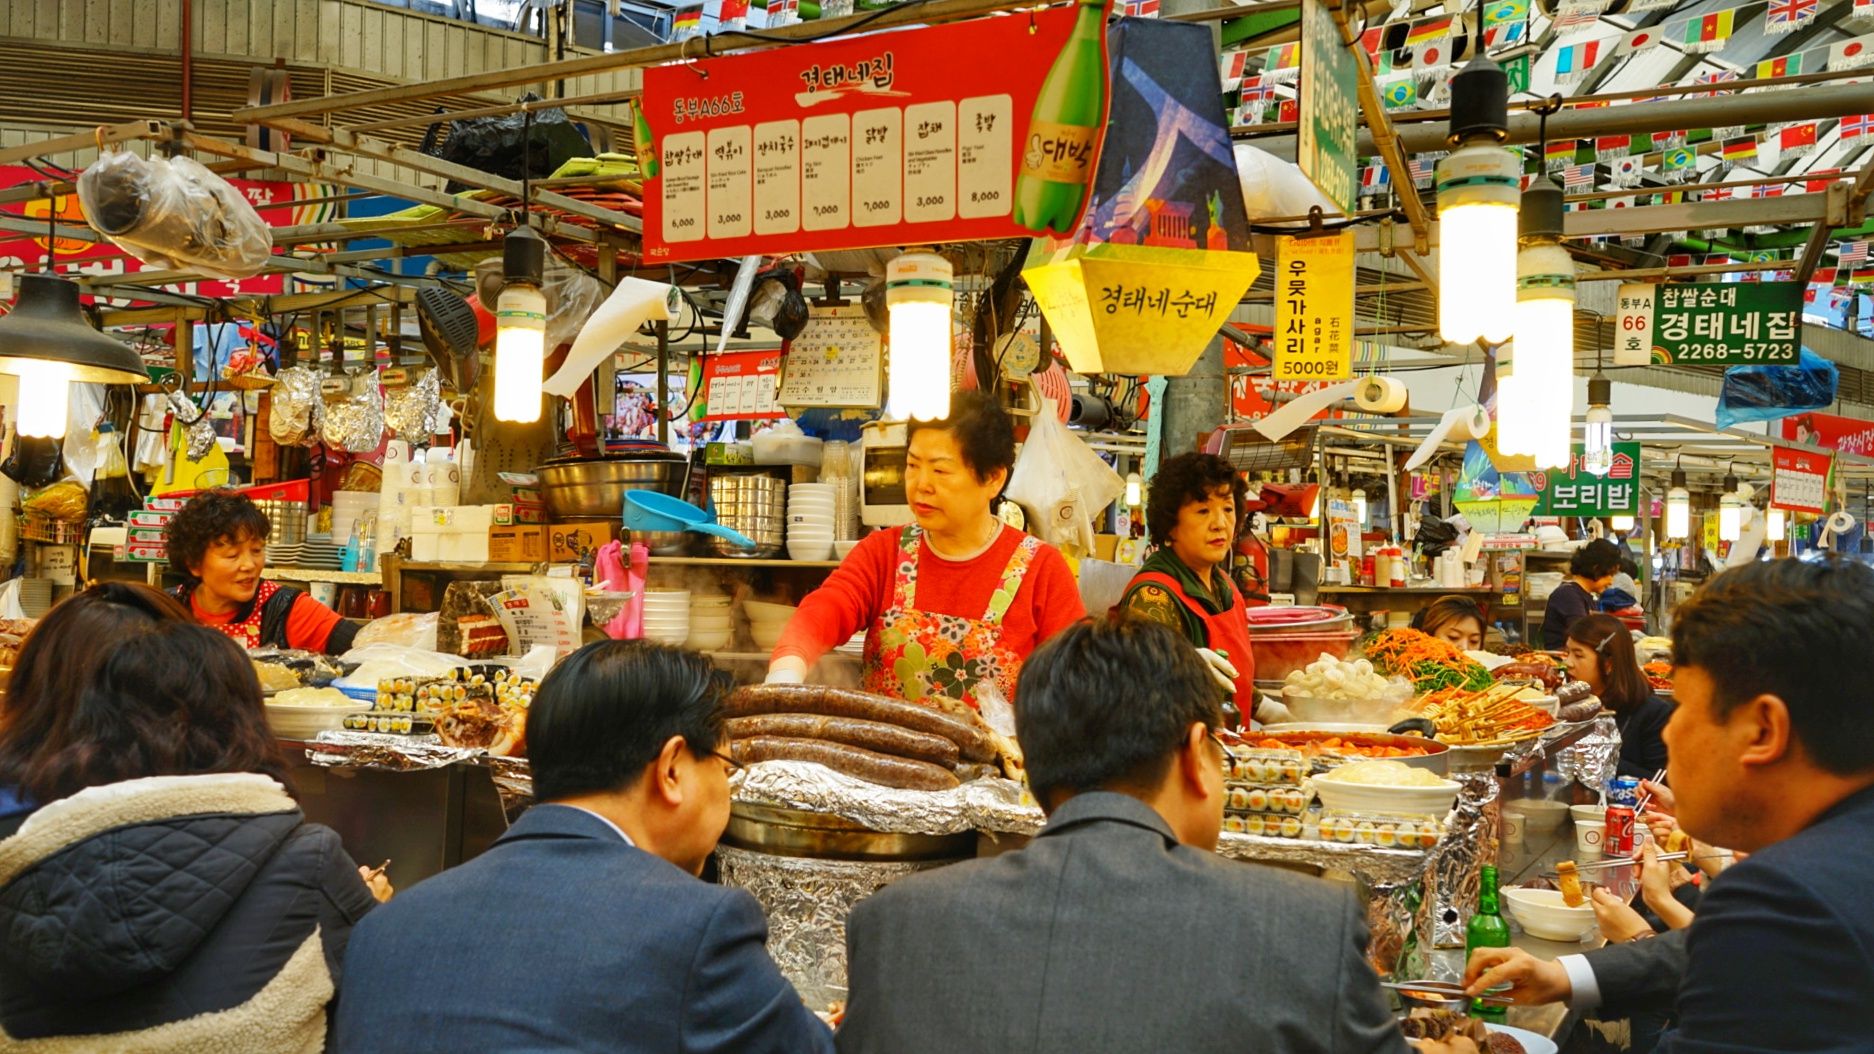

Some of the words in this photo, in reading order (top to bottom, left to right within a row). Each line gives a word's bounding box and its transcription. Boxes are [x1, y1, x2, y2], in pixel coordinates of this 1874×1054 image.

[801, 53, 893, 93] 경태네집
[673, 92, 744, 124] 동부A66호
[865, 126, 888, 145] 닭발
[918, 120, 942, 140] 잡채
[758, 135, 795, 156] 잔치국수
[917, 196, 944, 208] 3,000
[971, 191, 999, 203] 8,000
[813, 205, 839, 216] 7,000
[864, 200, 890, 212] 7,000
[672, 218, 695, 229] 6,000
[717, 213, 742, 225] 3,000
[765, 209, 790, 221] 3,000
[1101, 283, 1219, 319] 경태네순대
[1620, 298, 1652, 310] 동부A
[1662, 287, 1737, 308] 찹쌀순대
[1286, 260, 1307, 354] 우뭇가사리
[1623, 315, 1646, 332] 66
[1659, 311, 1797, 341] 경태네집
[1314, 317, 1322, 354] agar
[1624, 336, 1642, 352] 호
[1677, 343, 1793, 360] 2268-5723
[1282, 360, 1339, 376] 5000원
[1552, 483, 1633, 510] 보리밥
